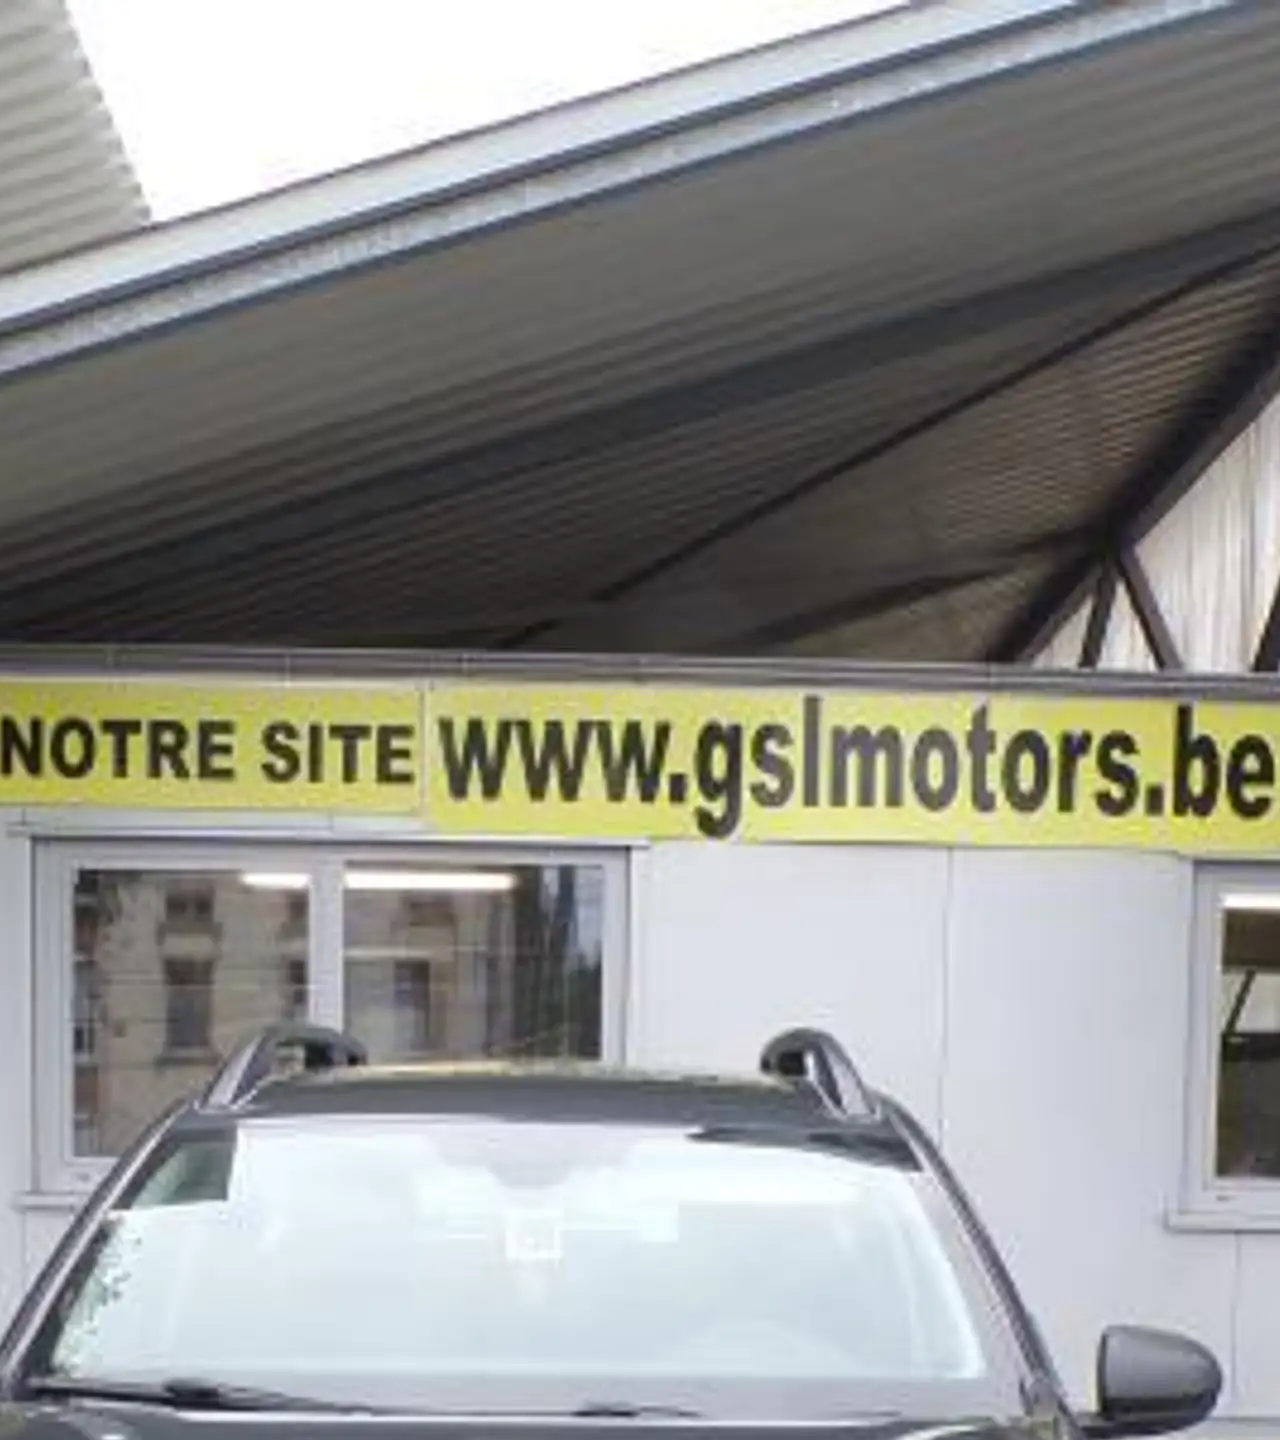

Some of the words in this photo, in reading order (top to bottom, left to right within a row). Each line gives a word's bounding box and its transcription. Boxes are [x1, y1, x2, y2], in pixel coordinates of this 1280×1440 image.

[0, 716, 237, 781] NOTRE
[261, 721, 417, 785] SITE
[438, 695, 1275, 837] www.gslmotors.be
